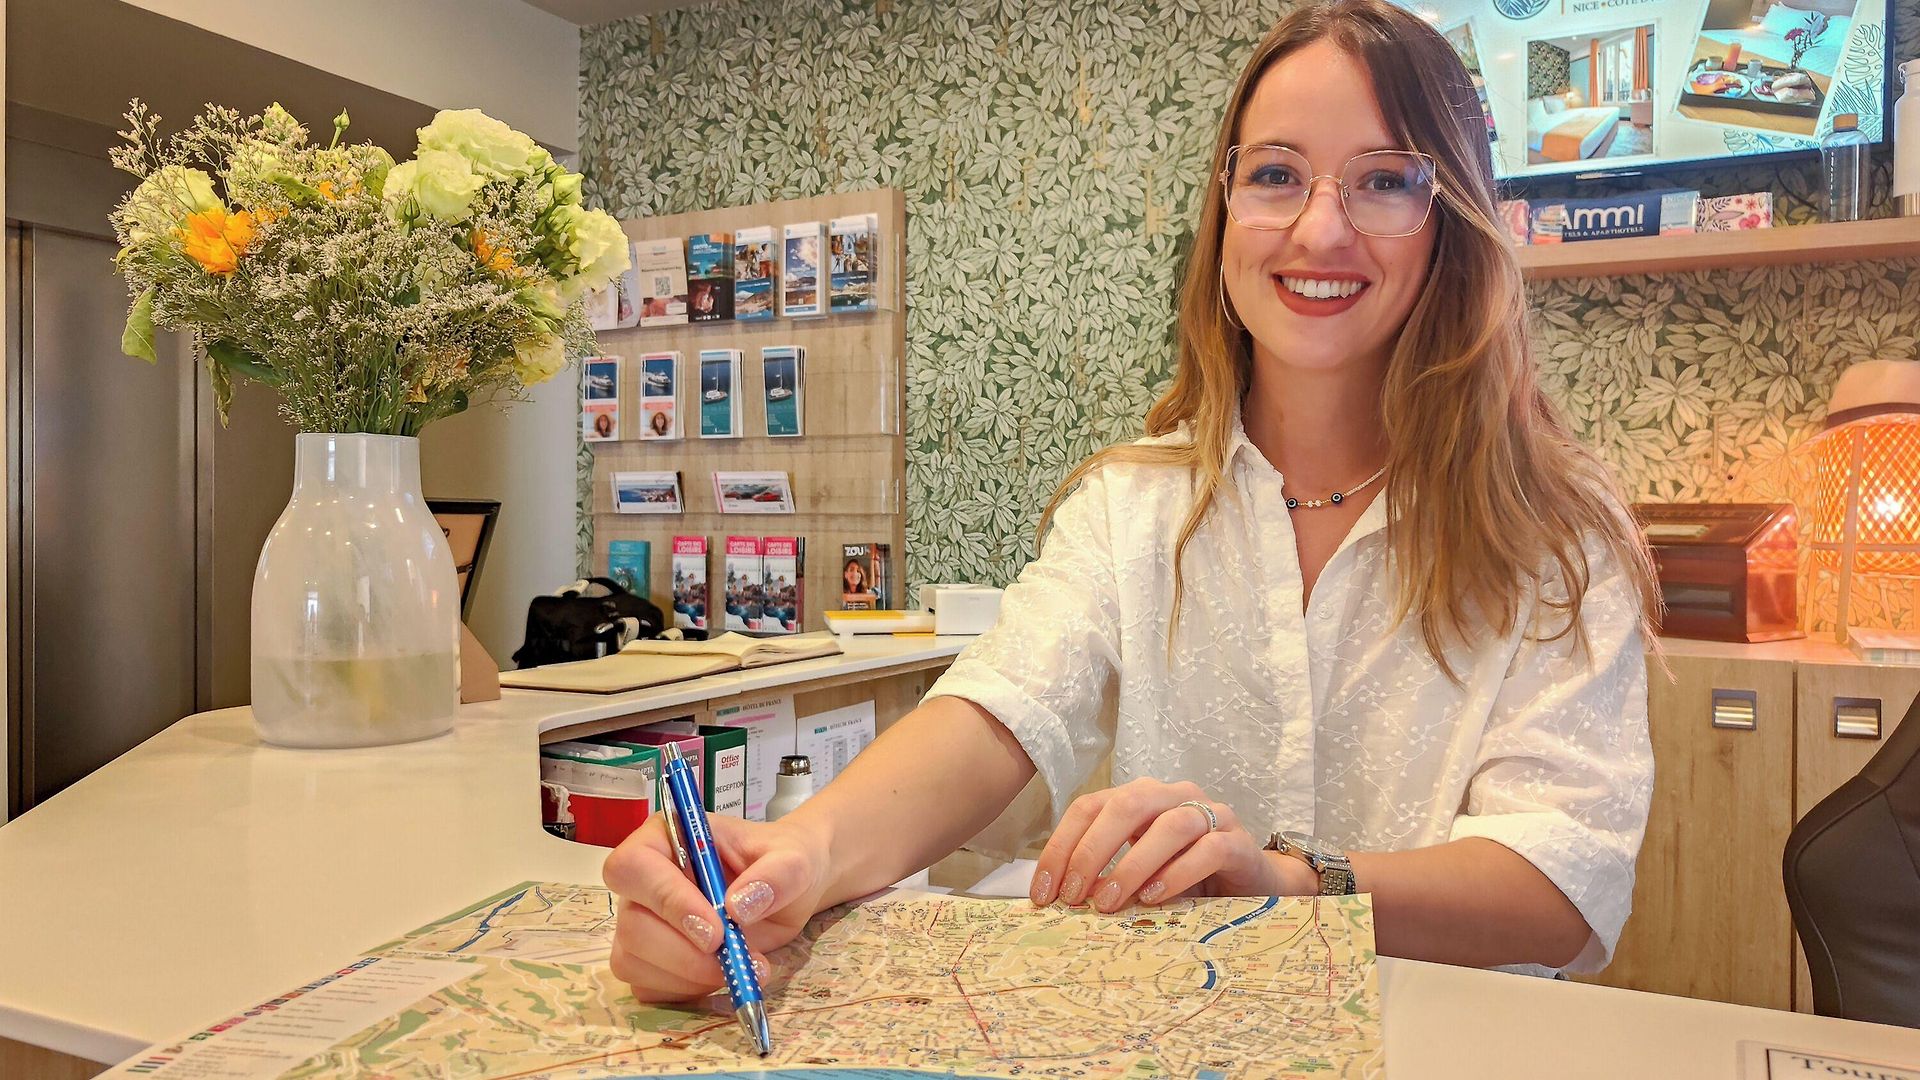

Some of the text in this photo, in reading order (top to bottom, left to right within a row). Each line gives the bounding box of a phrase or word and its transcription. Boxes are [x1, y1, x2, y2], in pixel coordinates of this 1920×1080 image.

[767, 547, 793, 555] LOISIRS
[721, 754, 740, 764] Office
[721, 761, 740, 770] DEPOT
[716, 780, 745, 794] RECEPTION
[716, 799, 742, 812] PLANNING
